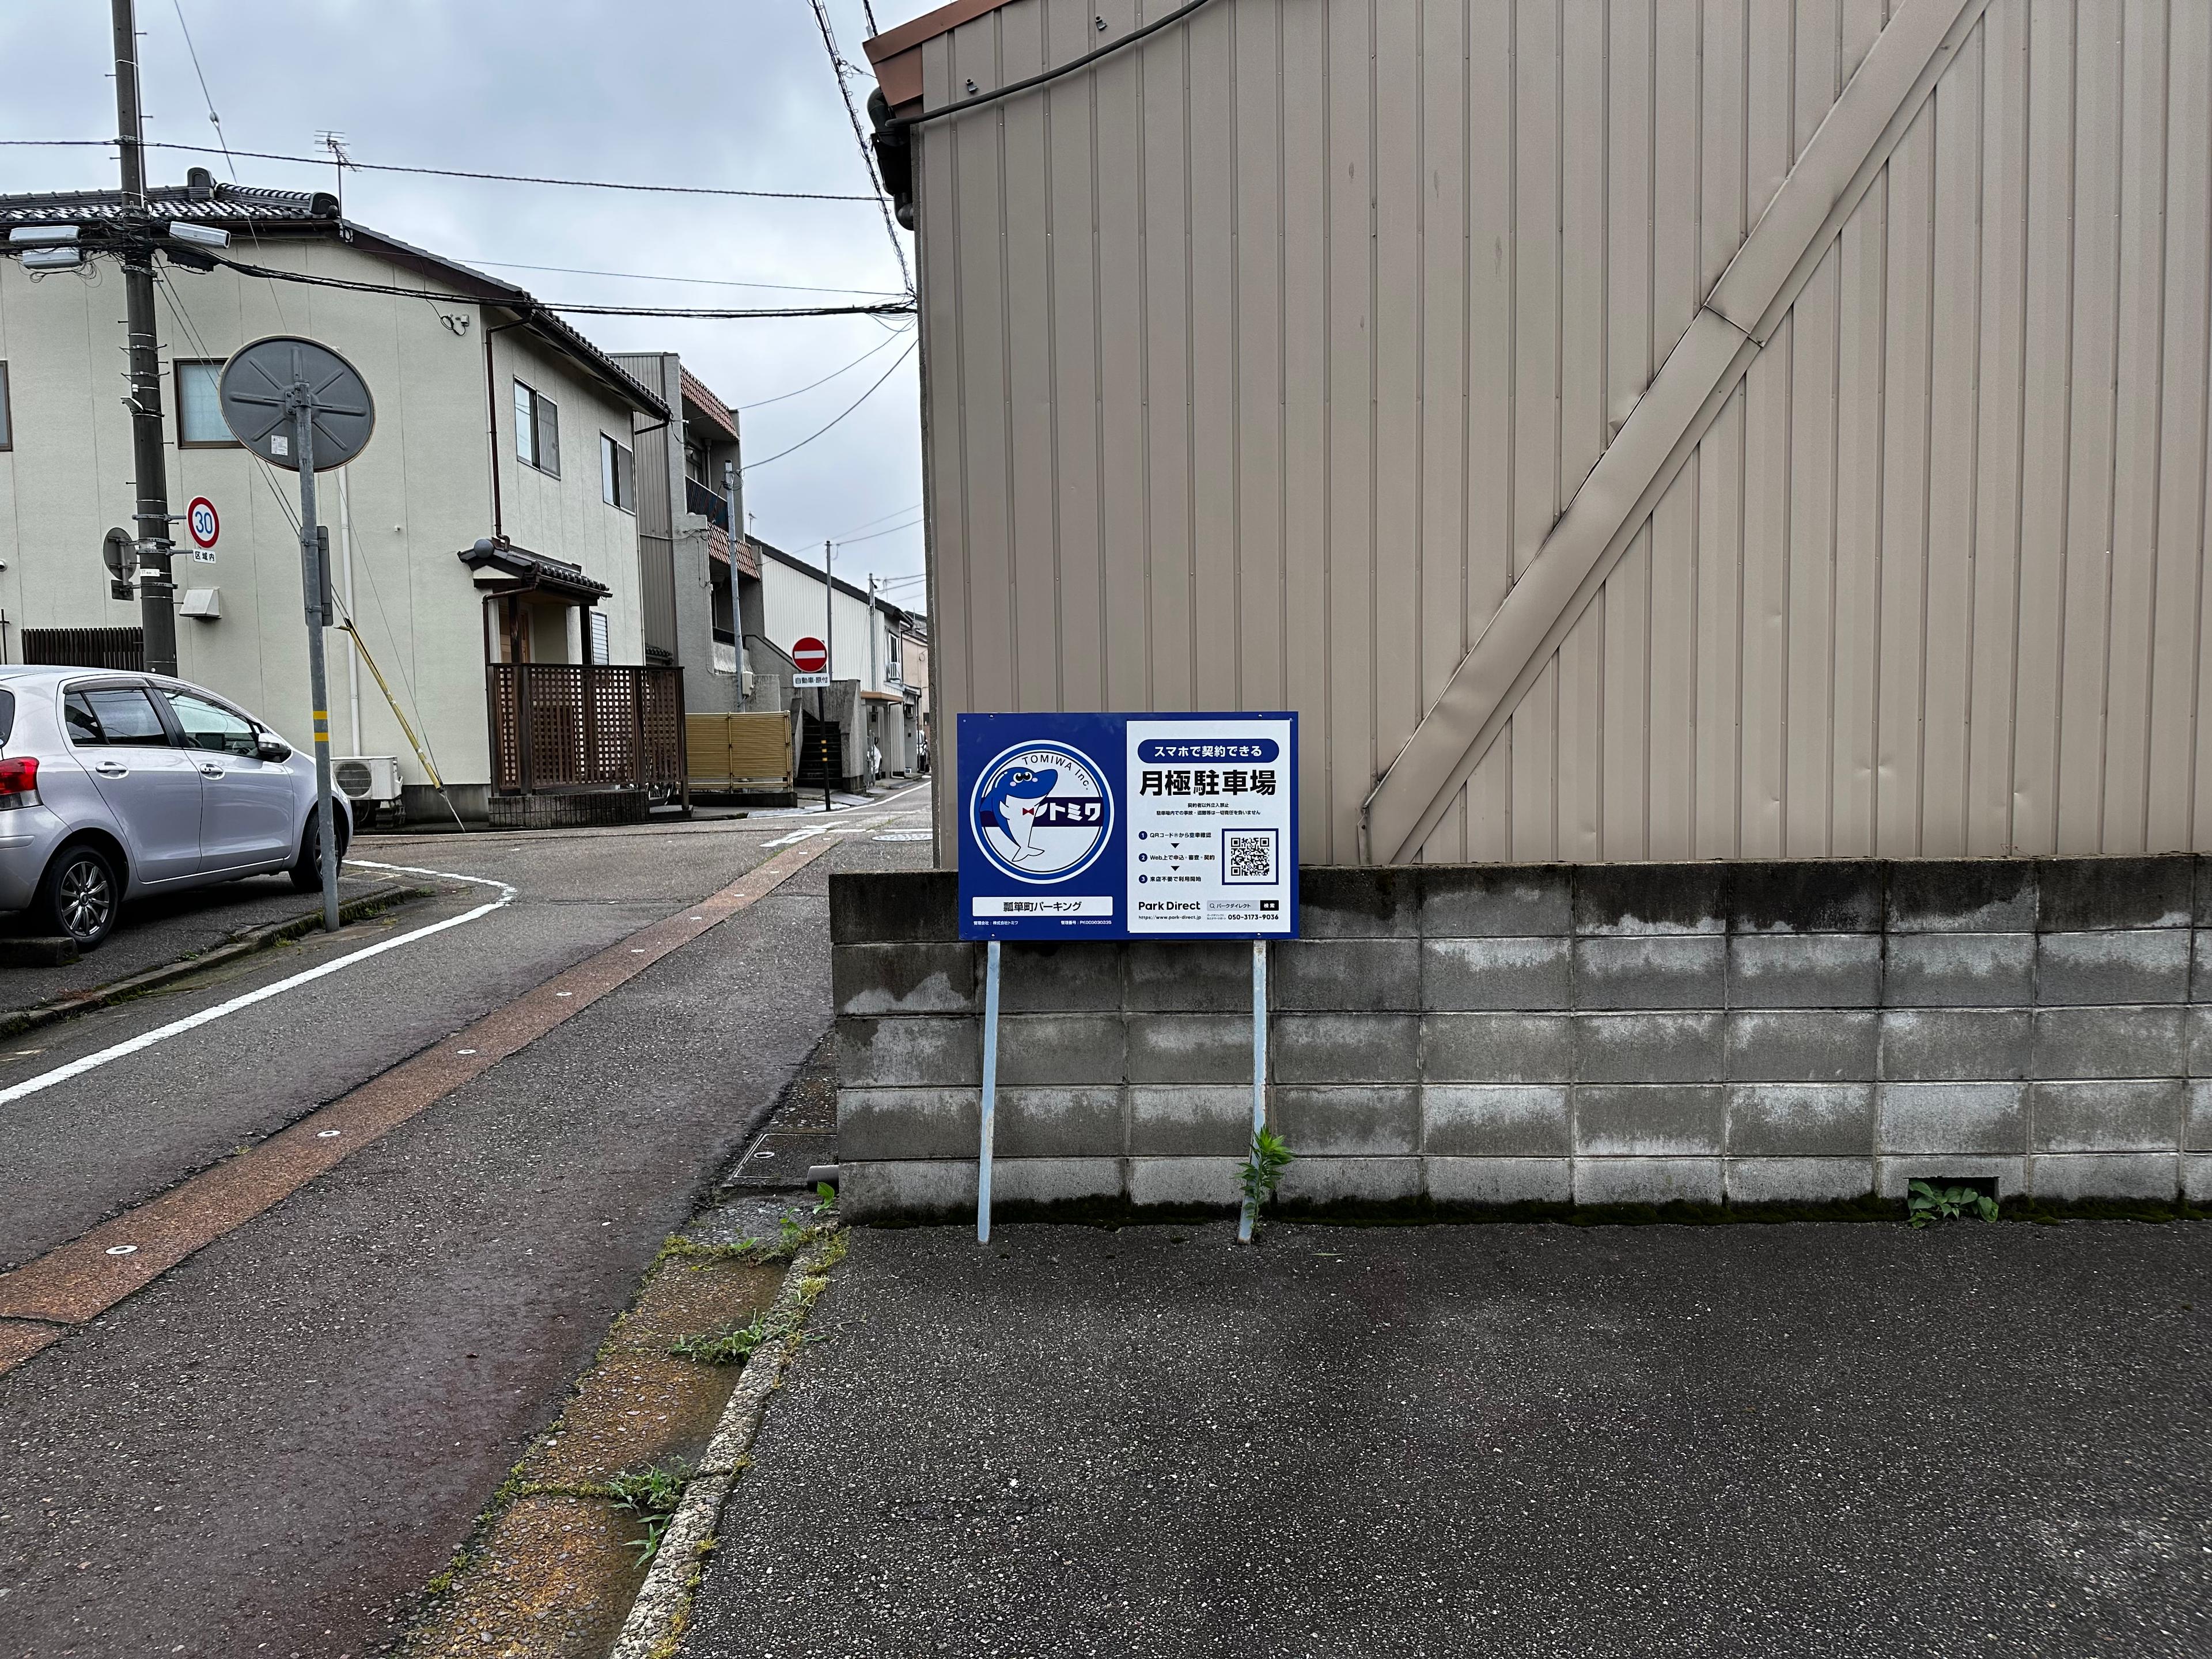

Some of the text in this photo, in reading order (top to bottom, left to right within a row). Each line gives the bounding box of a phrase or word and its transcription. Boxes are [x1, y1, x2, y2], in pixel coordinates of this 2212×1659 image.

[195, 511, 213, 535] 30
[195, 551, 215, 562] 区域内
[1154, 745, 1262, 757] スマホで契約できる
[1021, 754, 1089, 791] TOMIWA Inc.
[1139, 769, 1277, 796] 月極駐車場
[1049, 802, 1101, 821] トミワ
[1138, 900, 1201, 910] Park Direct
